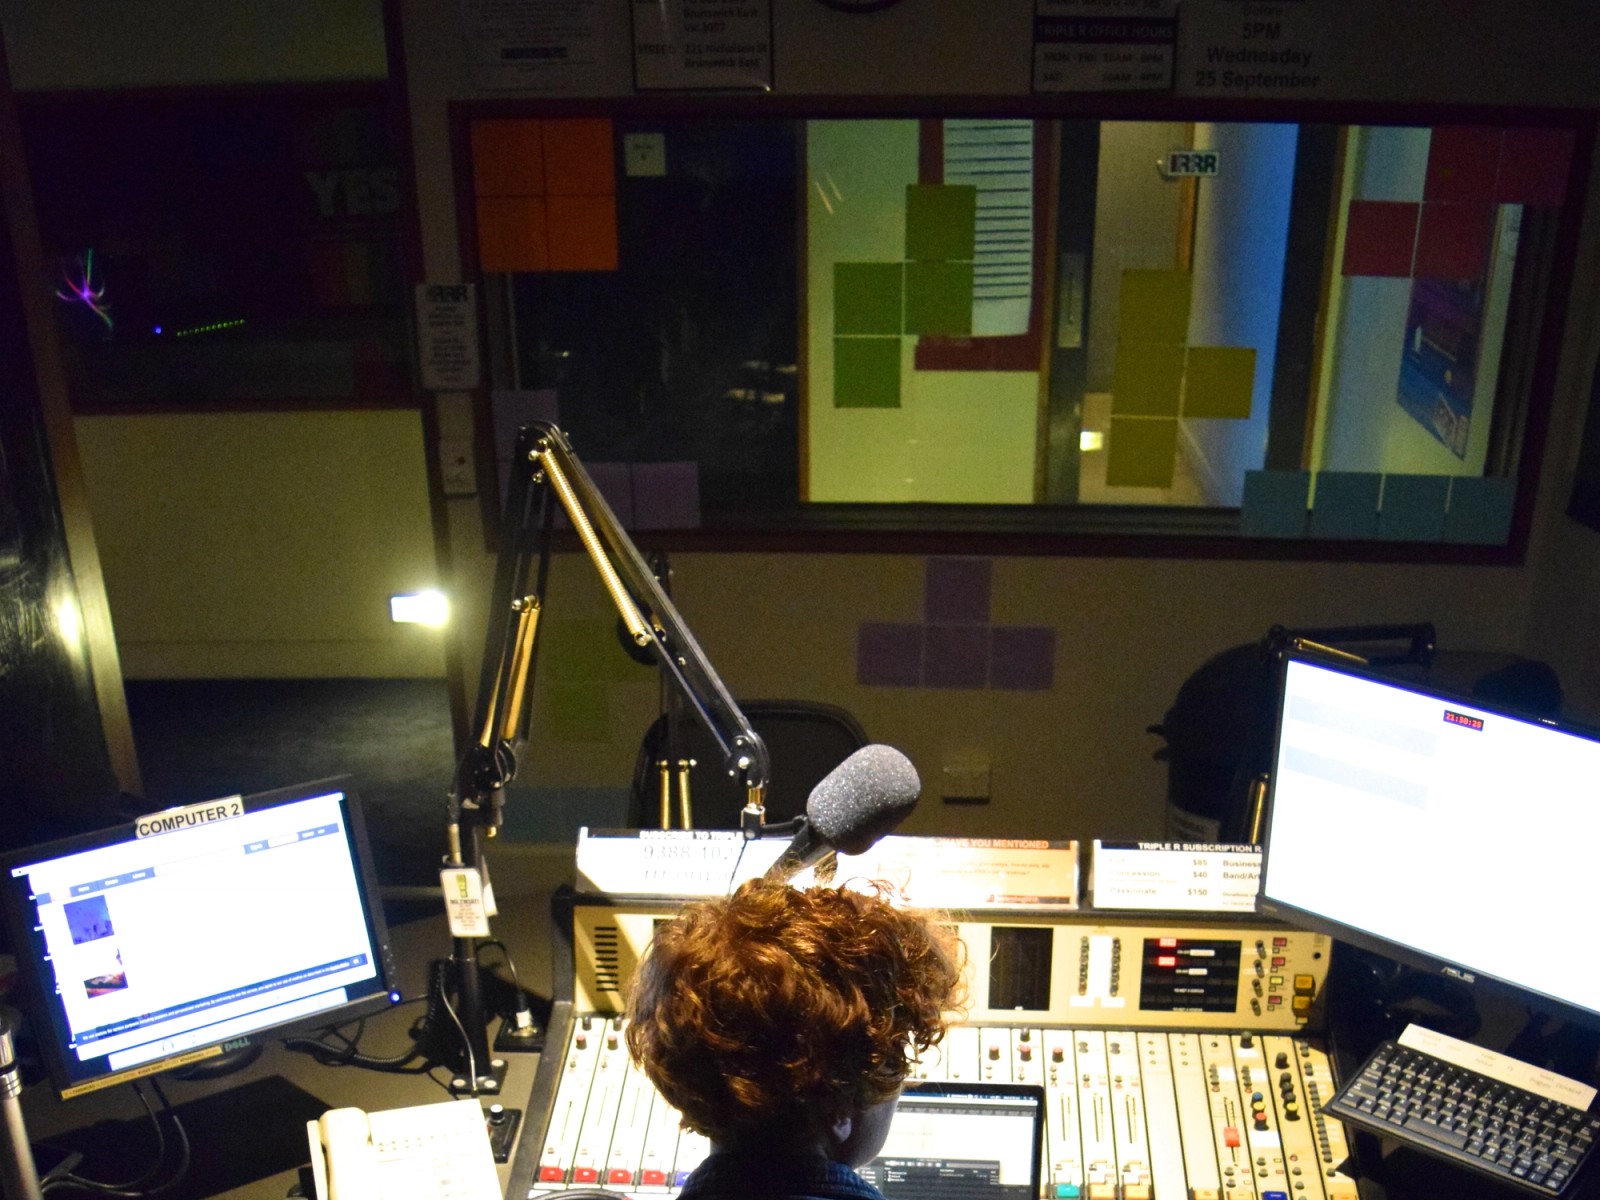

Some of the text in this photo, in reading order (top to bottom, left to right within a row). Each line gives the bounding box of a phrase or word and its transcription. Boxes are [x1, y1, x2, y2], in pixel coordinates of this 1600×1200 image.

[1038, 25, 1075, 36] TRIPLE
[1089, 25, 1129, 37] OFFICE
[1132, 26, 1174, 37] HOURS
[1242, 23, 1281, 39] 5PM
[1207, 46, 1312, 67] Wednesday
[1196, 70, 1320, 90] 25 September
[303, 167, 400, 216] YES
[139, 803, 241, 836] COMPUTER 2
[971, 840, 991, 849] YOU
[993, 840, 1049, 850] MENTIONED
[1138, 843, 1171, 851] TRIPLE
[1173, 843, 1181, 851] R
[1183, 843, 1252, 853] SUBSCRIPTION
[1187, 888, 1208, 897] $150
[225, 1037, 251, 1052] DELL
